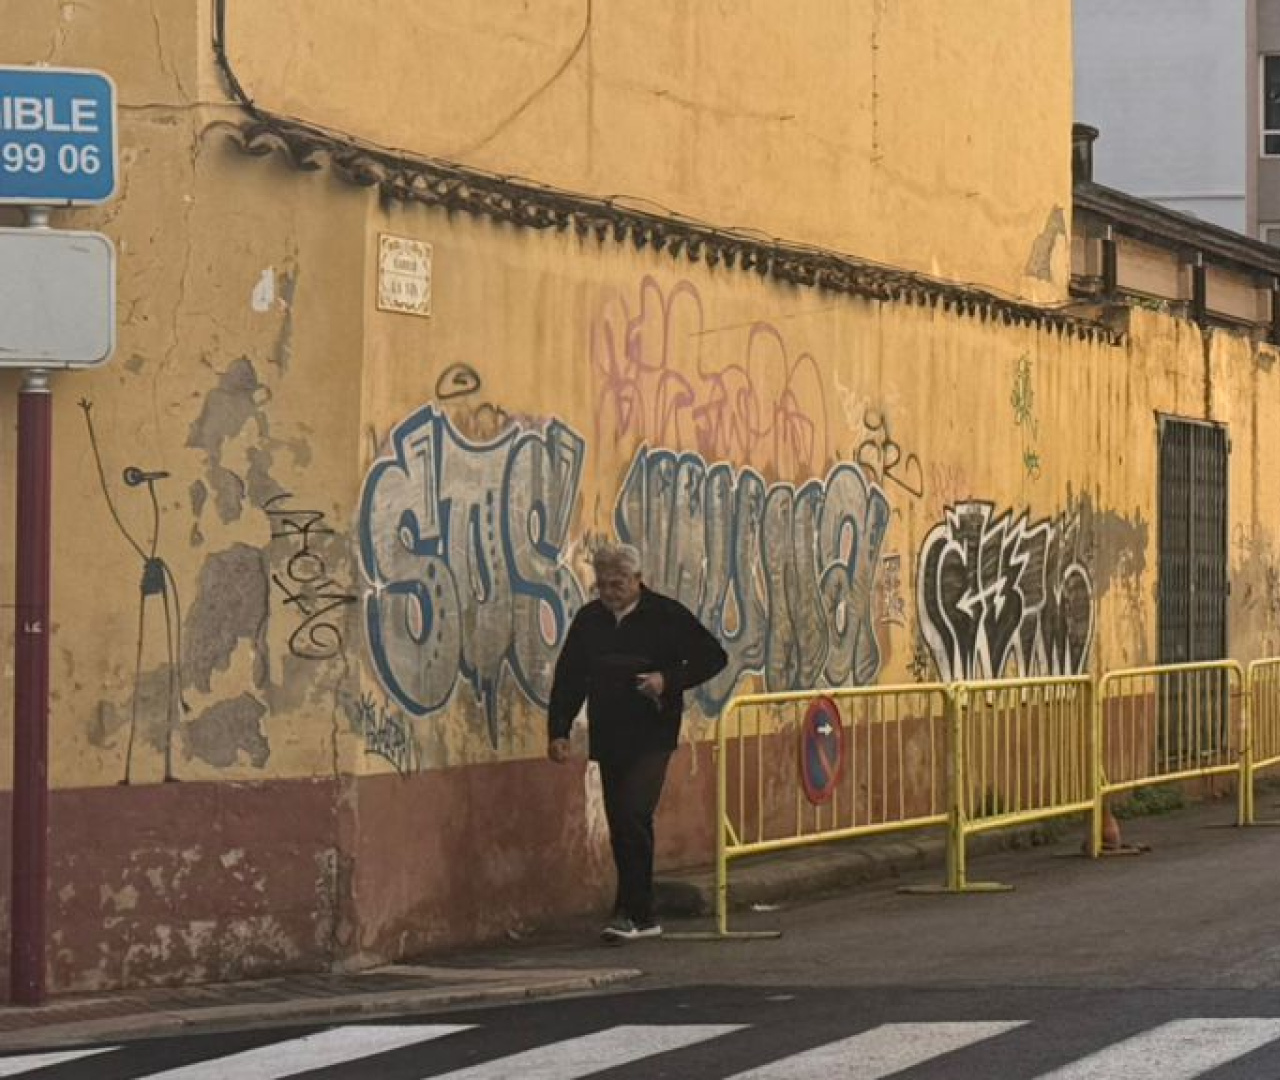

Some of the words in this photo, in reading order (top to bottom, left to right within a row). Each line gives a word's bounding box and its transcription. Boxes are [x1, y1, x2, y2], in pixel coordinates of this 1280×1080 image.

[3, 97, 99, 132] IBLE
[3, 142, 46, 173] 99
[58, 144, 100, 174] 06
